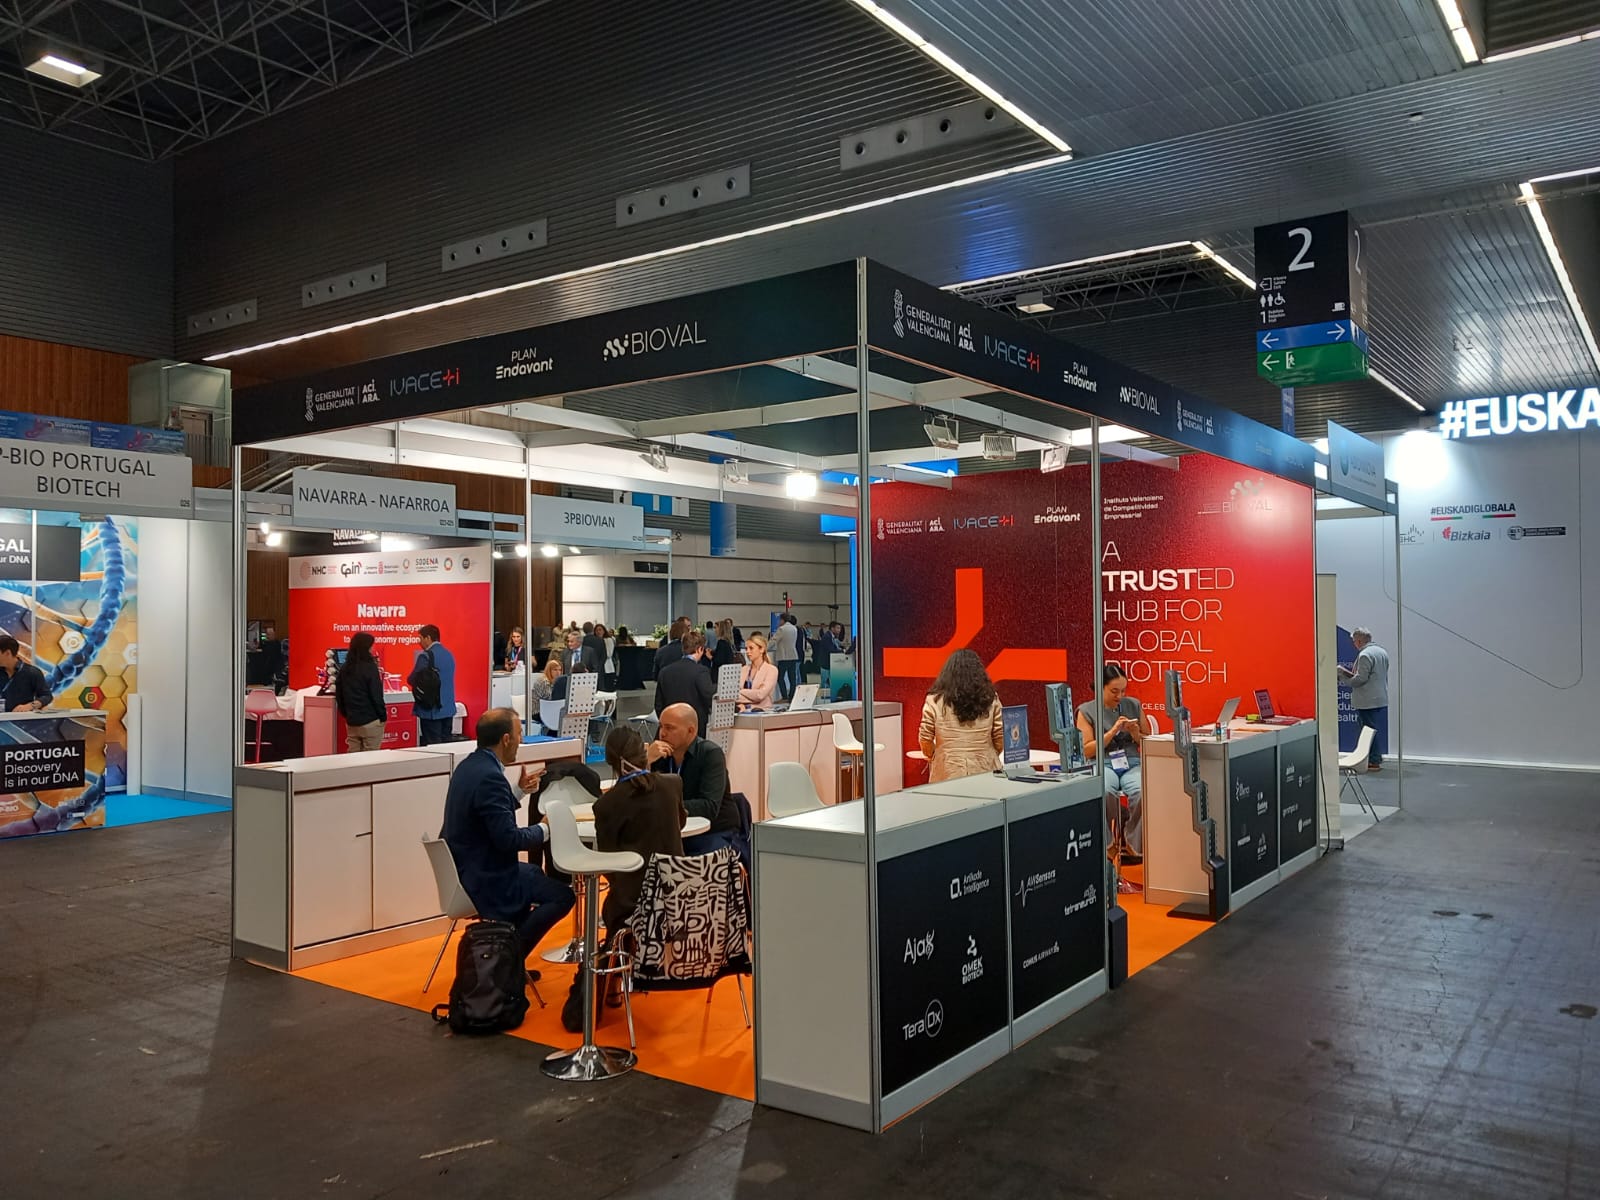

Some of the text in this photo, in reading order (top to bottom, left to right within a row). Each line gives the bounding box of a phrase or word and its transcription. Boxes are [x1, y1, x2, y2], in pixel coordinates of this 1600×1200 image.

[1288, 227, 1315, 272] 2
[906, 304, 952, 329] GENERALITAT
[631, 321, 706, 355] BIOVAL
[906, 318, 951, 345] VALENCIANA
[511, 347, 537, 362] PLAN
[495, 358, 553, 380] Endavant
[1073, 361, 1088, 376] PLAN
[1064, 370, 1097, 393] Endavant
[315, 386, 356, 402] GENERALITAT
[1131, 388, 1161, 416] BIOVAL
[315, 399, 355, 412] VALENCIANA
[0, 447, 156, 477] -BIO PORTUGAL
[37, 475, 121, 498] BIOTECH
[299, 487, 367, 506] NAVARRA
[379, 493, 450, 513] NAFARROA
[1046, 506, 1067, 514] PLAN
[1430, 502, 1516, 516] #EUSKADIGLOBALA
[563, 511, 615, 529] 3PBIOVIAN
[885, 520, 923, 529] GENERALITAT
[1034, 513, 1080, 524] Endavant
[886, 527, 923, 535] VALENCIANA
[1450, 530, 1491, 542] Bizkaia
[9, 555, 30, 564] DNA
[1102, 541, 1121, 562] A
[312, 566, 327, 576] NHC
[1101, 567, 1234, 592] TRUSTED
[357, 603, 407, 618] Navarra
[1103, 598, 1223, 622] HUB FOR
[333, 623, 350, 632] From
[361, 622, 394, 632] innovative
[1103, 629, 1214, 652] GLOBAL
[5, 747, 80, 762] PORTUGAL
[5, 763, 62, 775] Discovery
[5, 771, 80, 788] is in our DNA
